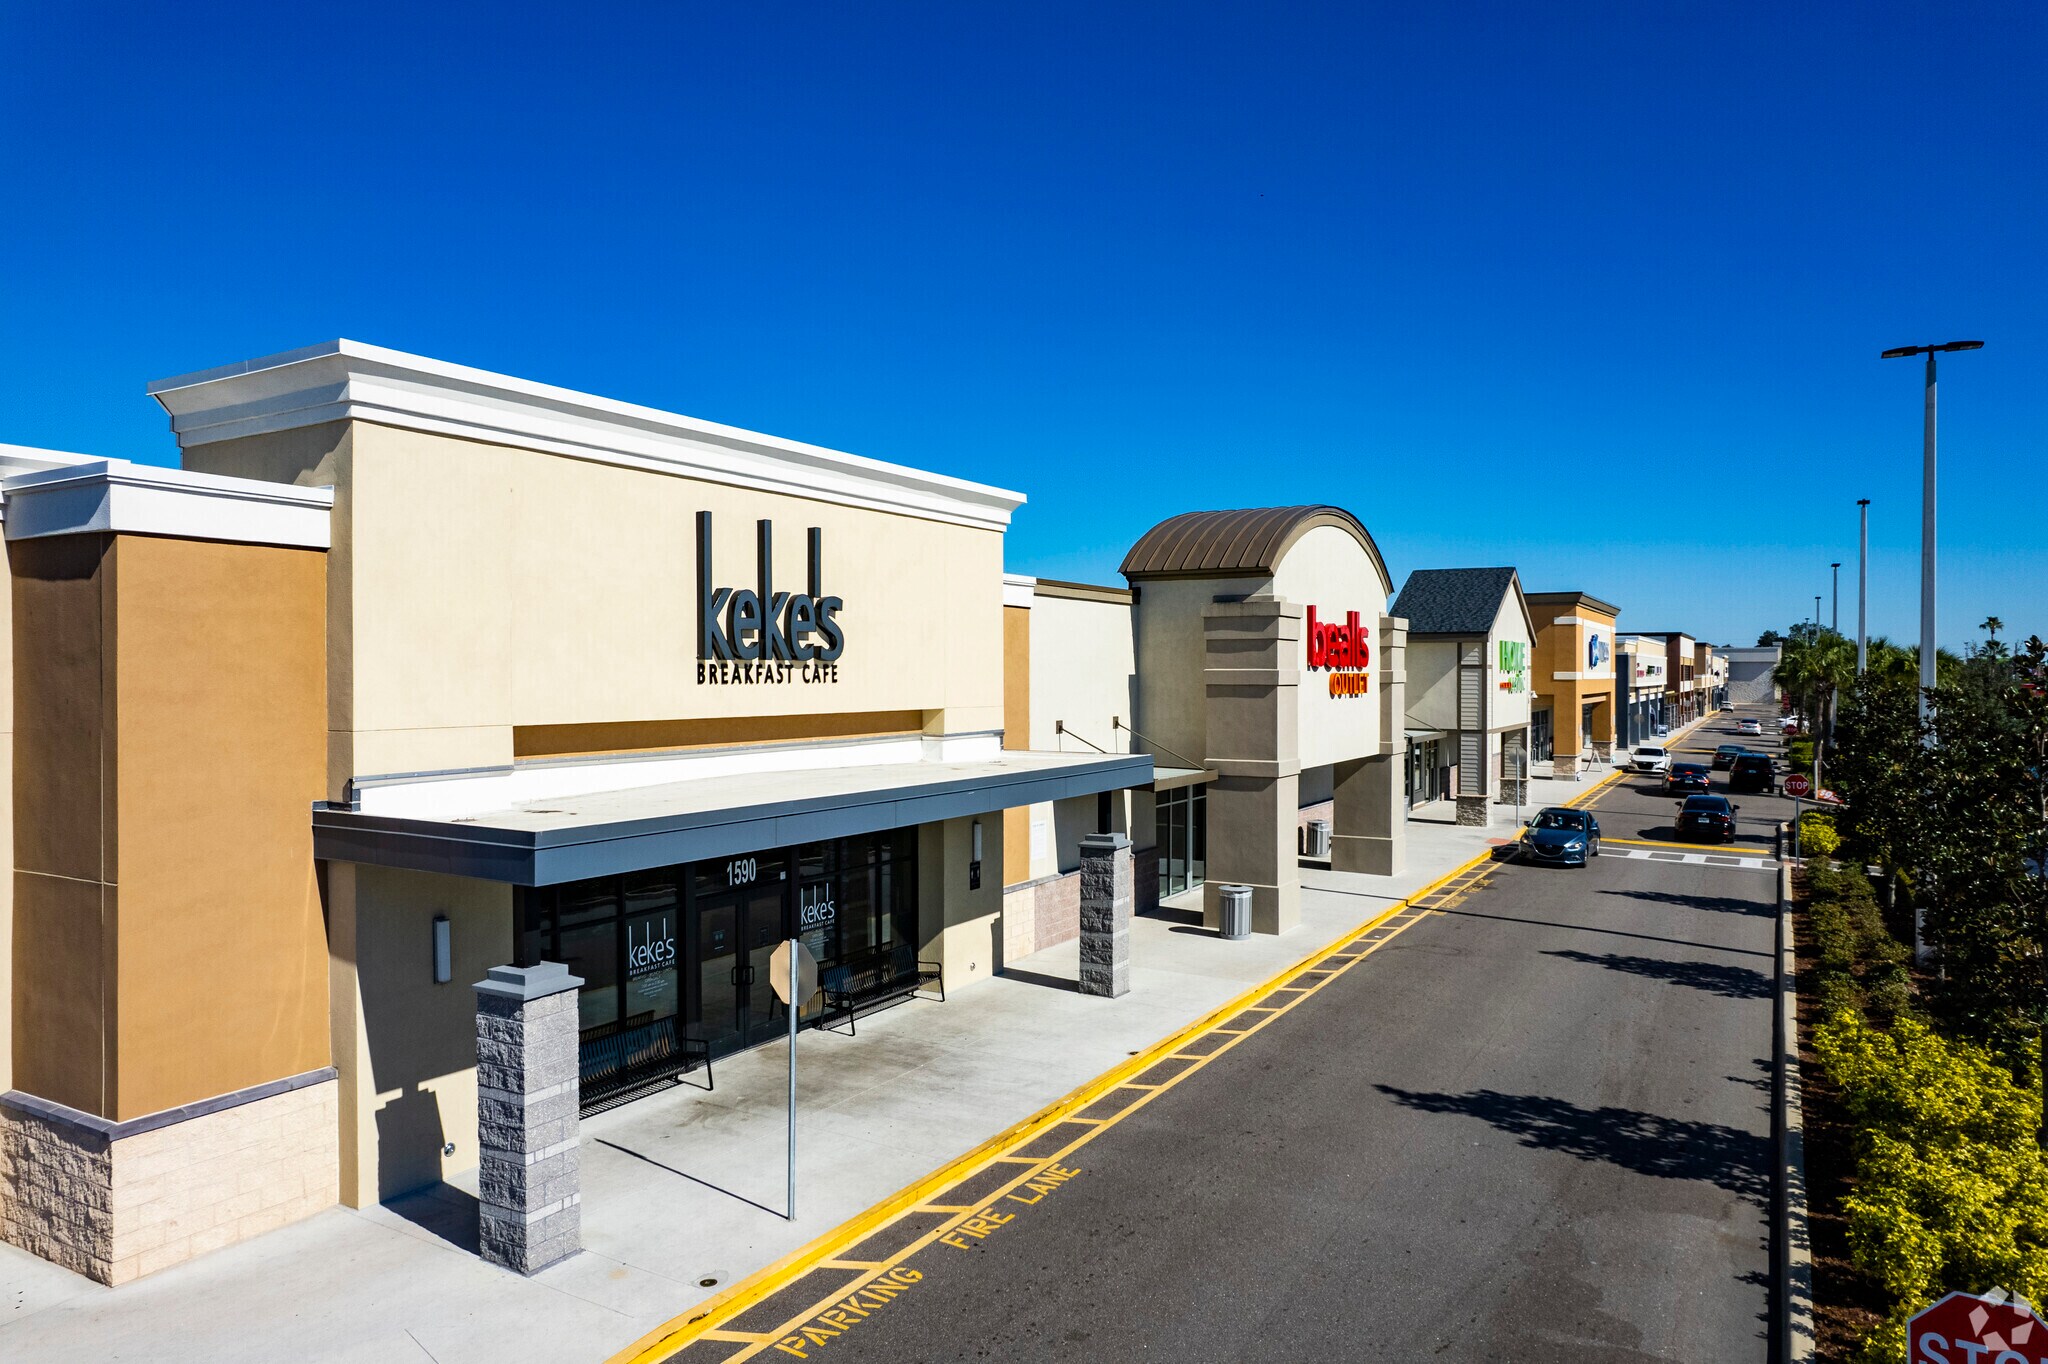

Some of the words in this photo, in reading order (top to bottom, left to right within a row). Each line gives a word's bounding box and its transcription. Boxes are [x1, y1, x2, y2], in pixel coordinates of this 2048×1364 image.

[1306, 604, 1369, 669] bealls
[1499, 640, 1525, 671] HOME
[697, 663, 793, 685] BREAKFAST
[801, 664, 838, 684] CAFE
[1328, 672, 1369, 695] OUTLET
[1785, 781, 1808, 790] STOP
[727, 857, 756, 886] 1590
[800, 882, 835, 925] keke's
[628, 917, 675, 969] keke's
[629, 962, 661, 976] BREAKFAST
[661, 958, 675, 968] CAFE
[774, 1267, 924, 1360] PARKING
[939, 1207, 1015, 1250] FIRE
[1006, 1163, 1082, 1205] LANE
